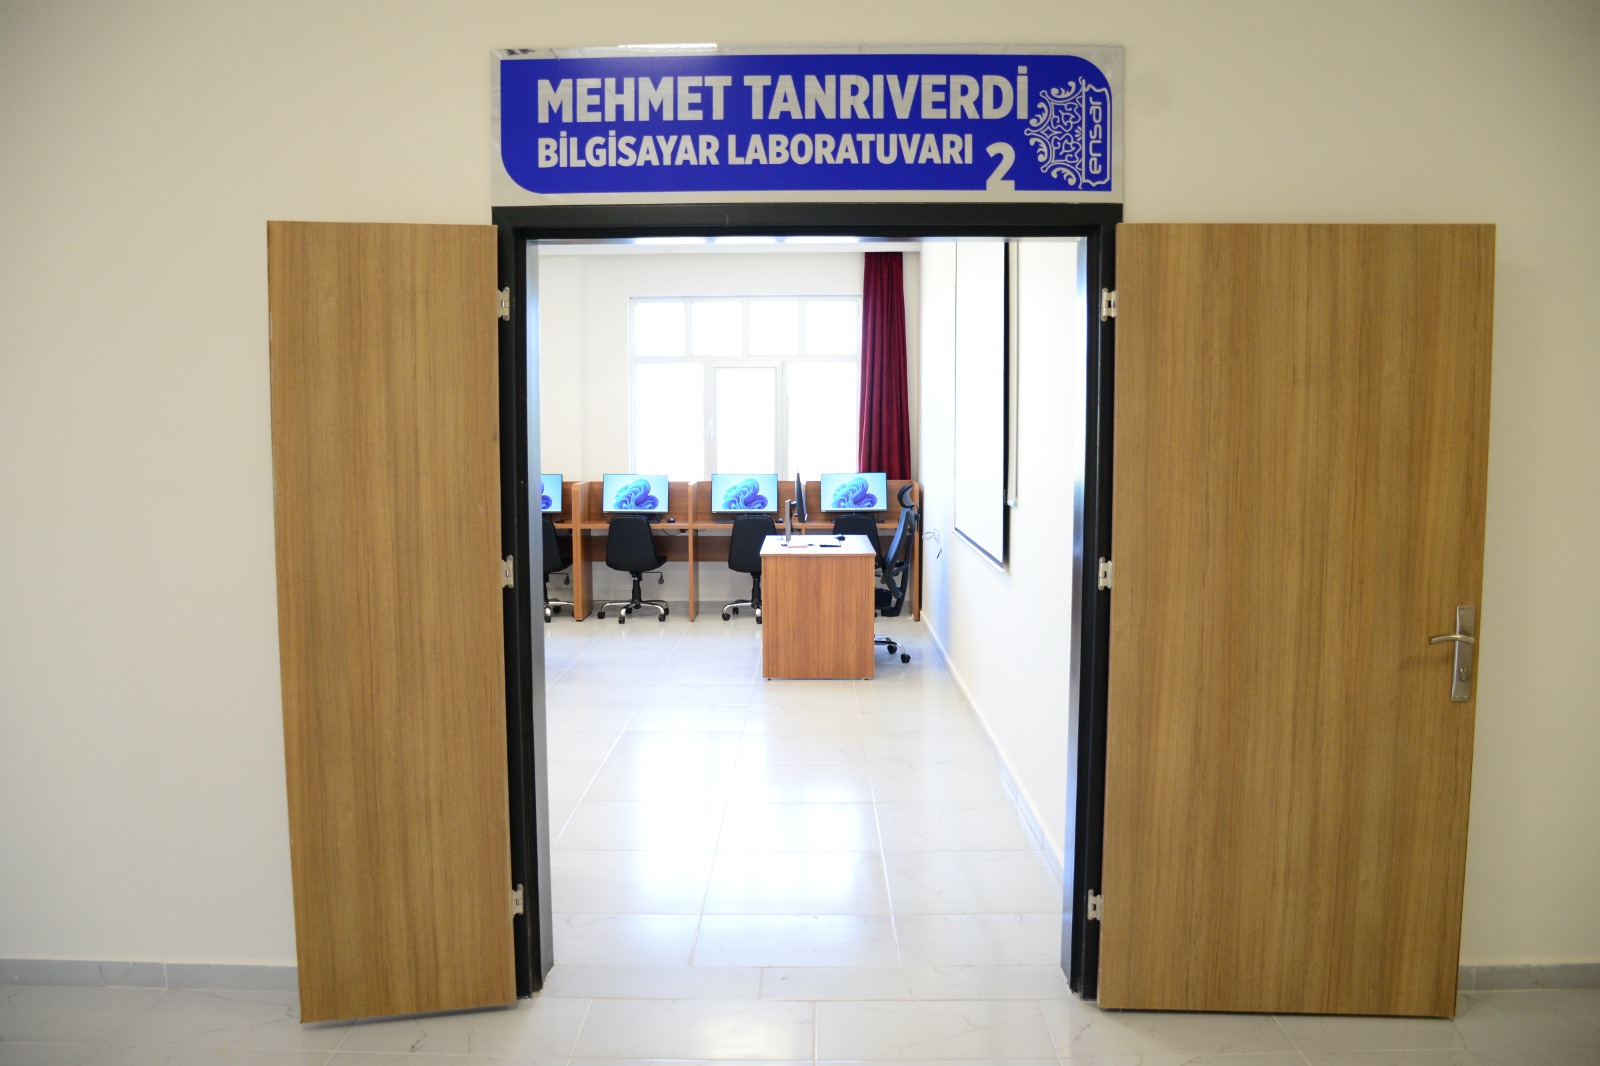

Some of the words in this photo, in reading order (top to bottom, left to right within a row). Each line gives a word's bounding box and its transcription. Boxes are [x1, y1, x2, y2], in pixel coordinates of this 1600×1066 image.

[538, 76, 732, 123] MEHMET
[743, 65, 1028, 120] TANRIVERDİ
[538, 131, 720, 168] BİLGİSAYAR
[727, 133, 973, 165] LABORATUVARI
[986, 142, 1015, 191] 2
[1089, 96, 1102, 175] ensar
